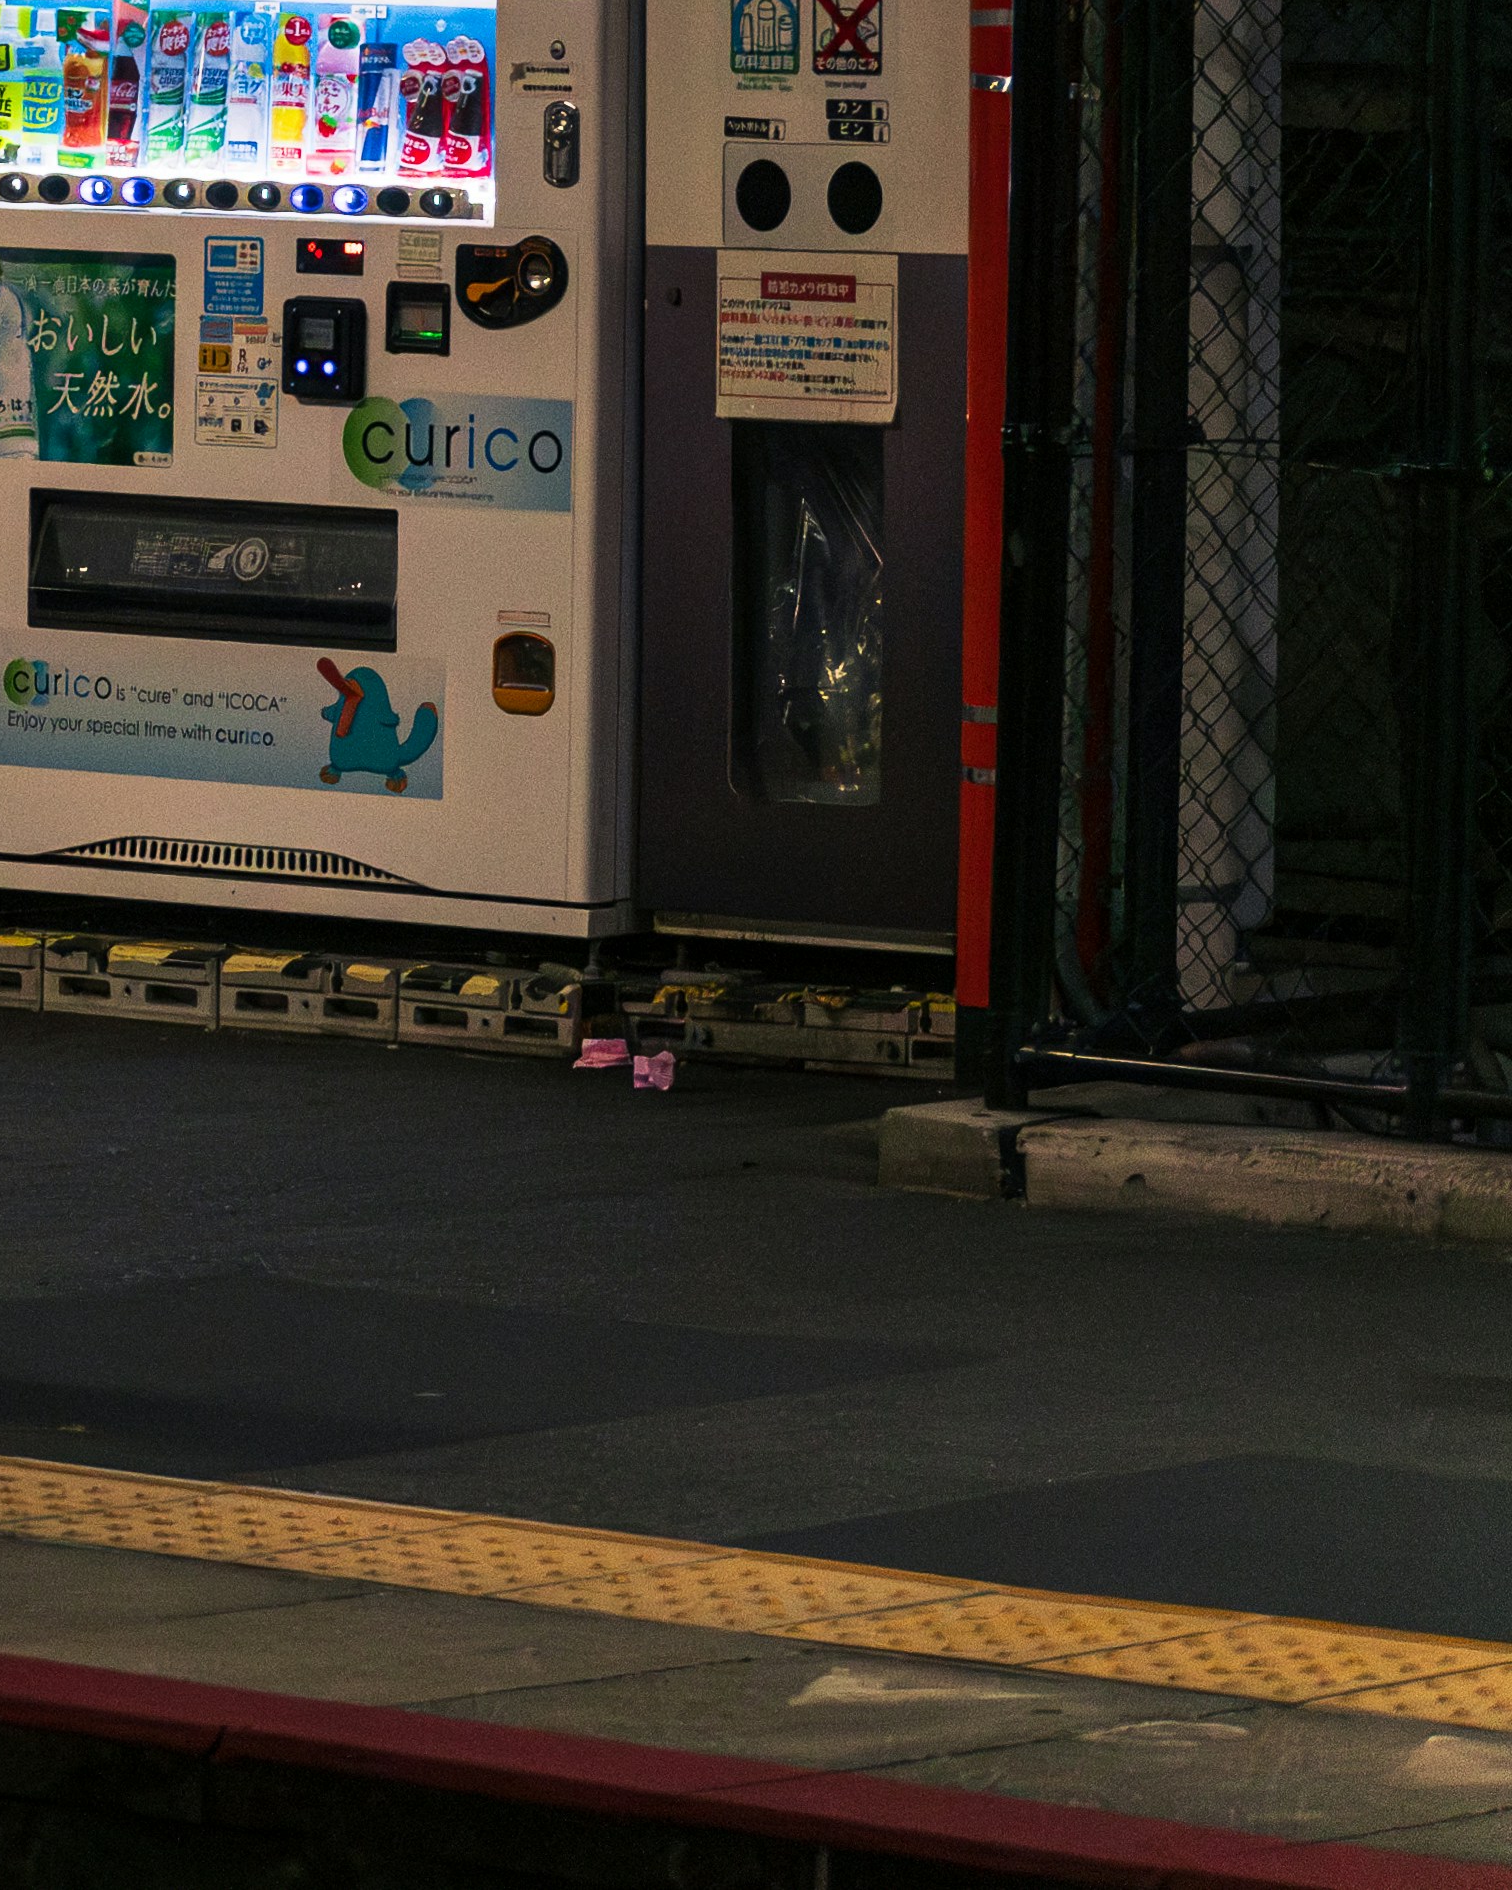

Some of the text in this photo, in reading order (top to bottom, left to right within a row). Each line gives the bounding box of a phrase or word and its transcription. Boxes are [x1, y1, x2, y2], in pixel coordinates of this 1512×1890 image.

[838, 101, 863, 114] カン
[27, 308, 157, 356] おいしい
[47, 370, 171, 420] 天然水。
[362, 414, 563, 474] curico
[13, 668, 112, 699] curico
[117, 684, 125, 701] is
[183, 691, 213, 708] and
[8, 710, 46, 732] Enjoy
[51, 717, 82, 733] your
[86, 718, 139, 737] special
[145, 721, 177, 739] time
[181, 723, 211, 741] with
